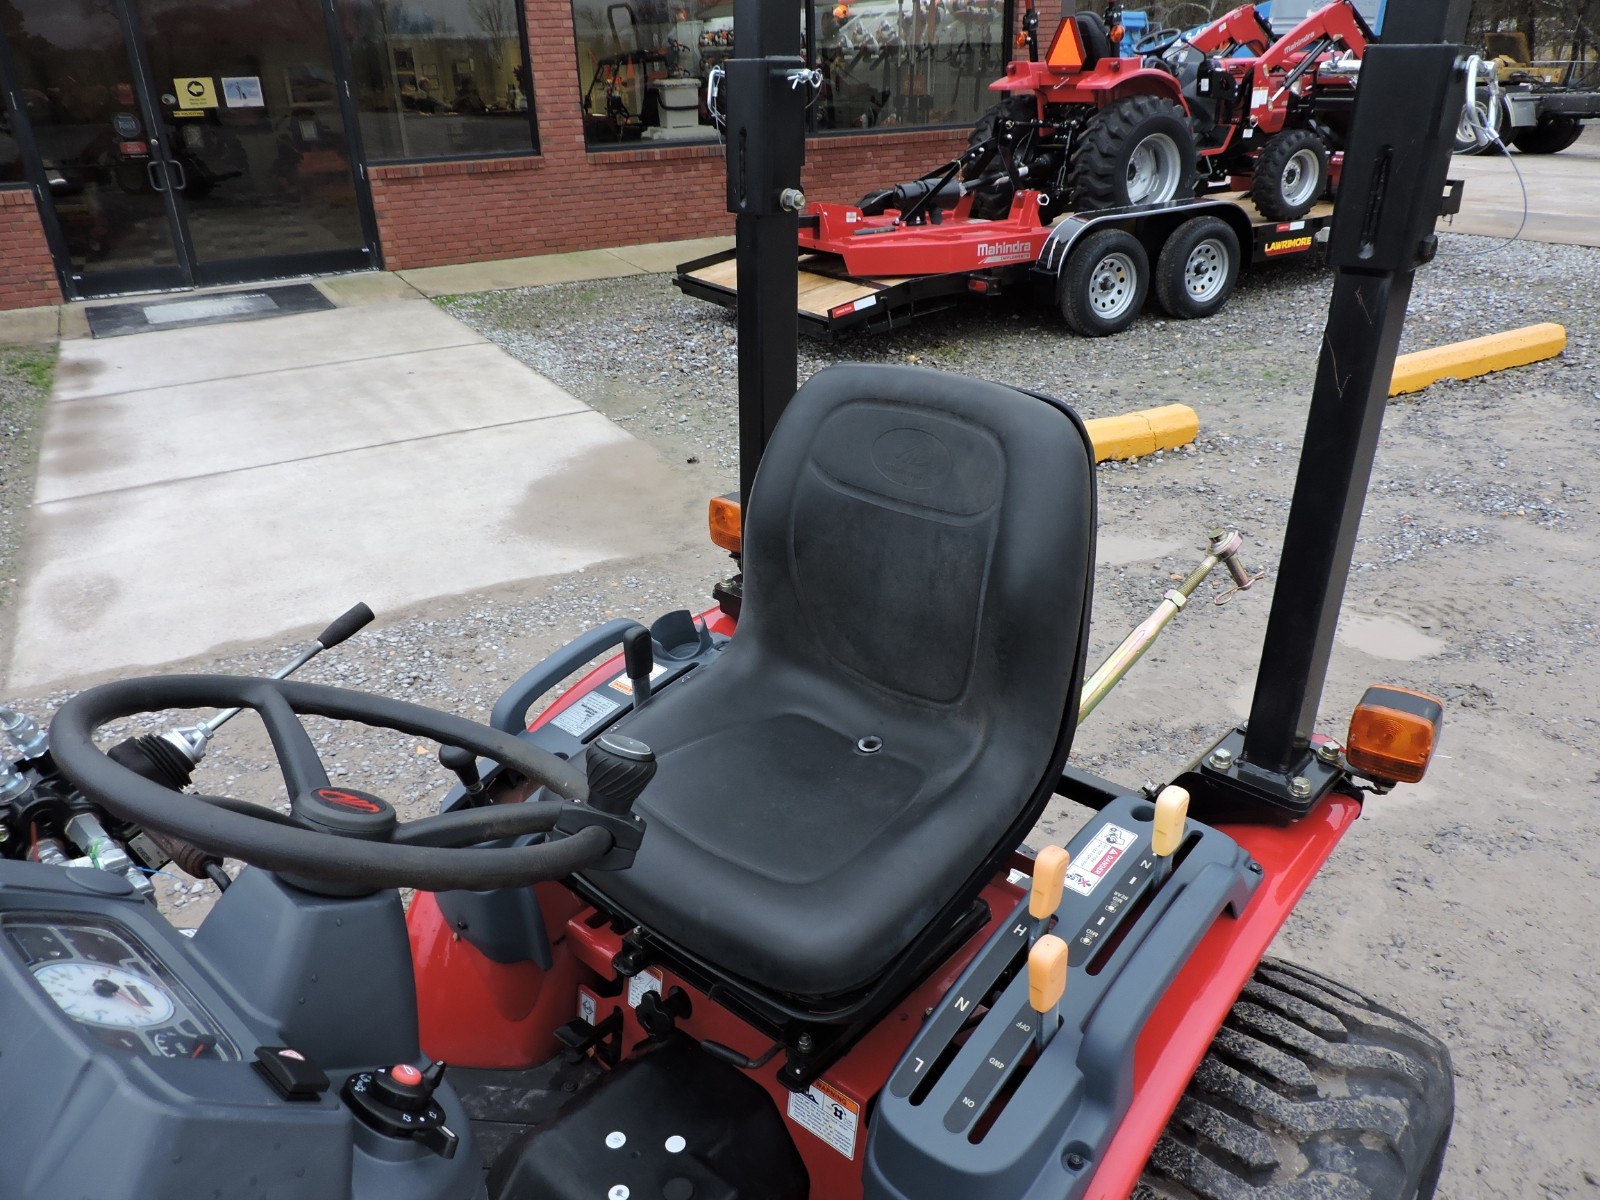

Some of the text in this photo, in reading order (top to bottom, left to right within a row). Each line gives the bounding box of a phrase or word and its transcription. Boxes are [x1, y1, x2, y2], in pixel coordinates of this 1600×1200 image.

[1284, 31, 1315, 54] Mahindra
[977, 241, 1031, 256] Mahindra
[1265, 236, 1312, 251] LAWRIMORE
[1094, 855, 1114, 874] DANGER
[1112, 896, 1124, 904] MID
[1113, 891, 1129, 901] REAR
[1013, 924, 1027, 937] H
[1085, 928, 1099, 938] MID
[954, 997, 970, 1012] N
[1015, 1021, 1031, 1032] OFF
[915, 1057, 925, 1073] L
[988, 1057, 1005, 1070] 4WD
[815, 1081, 847, 1106] WARNING
[962, 1096, 975, 1108] ON
